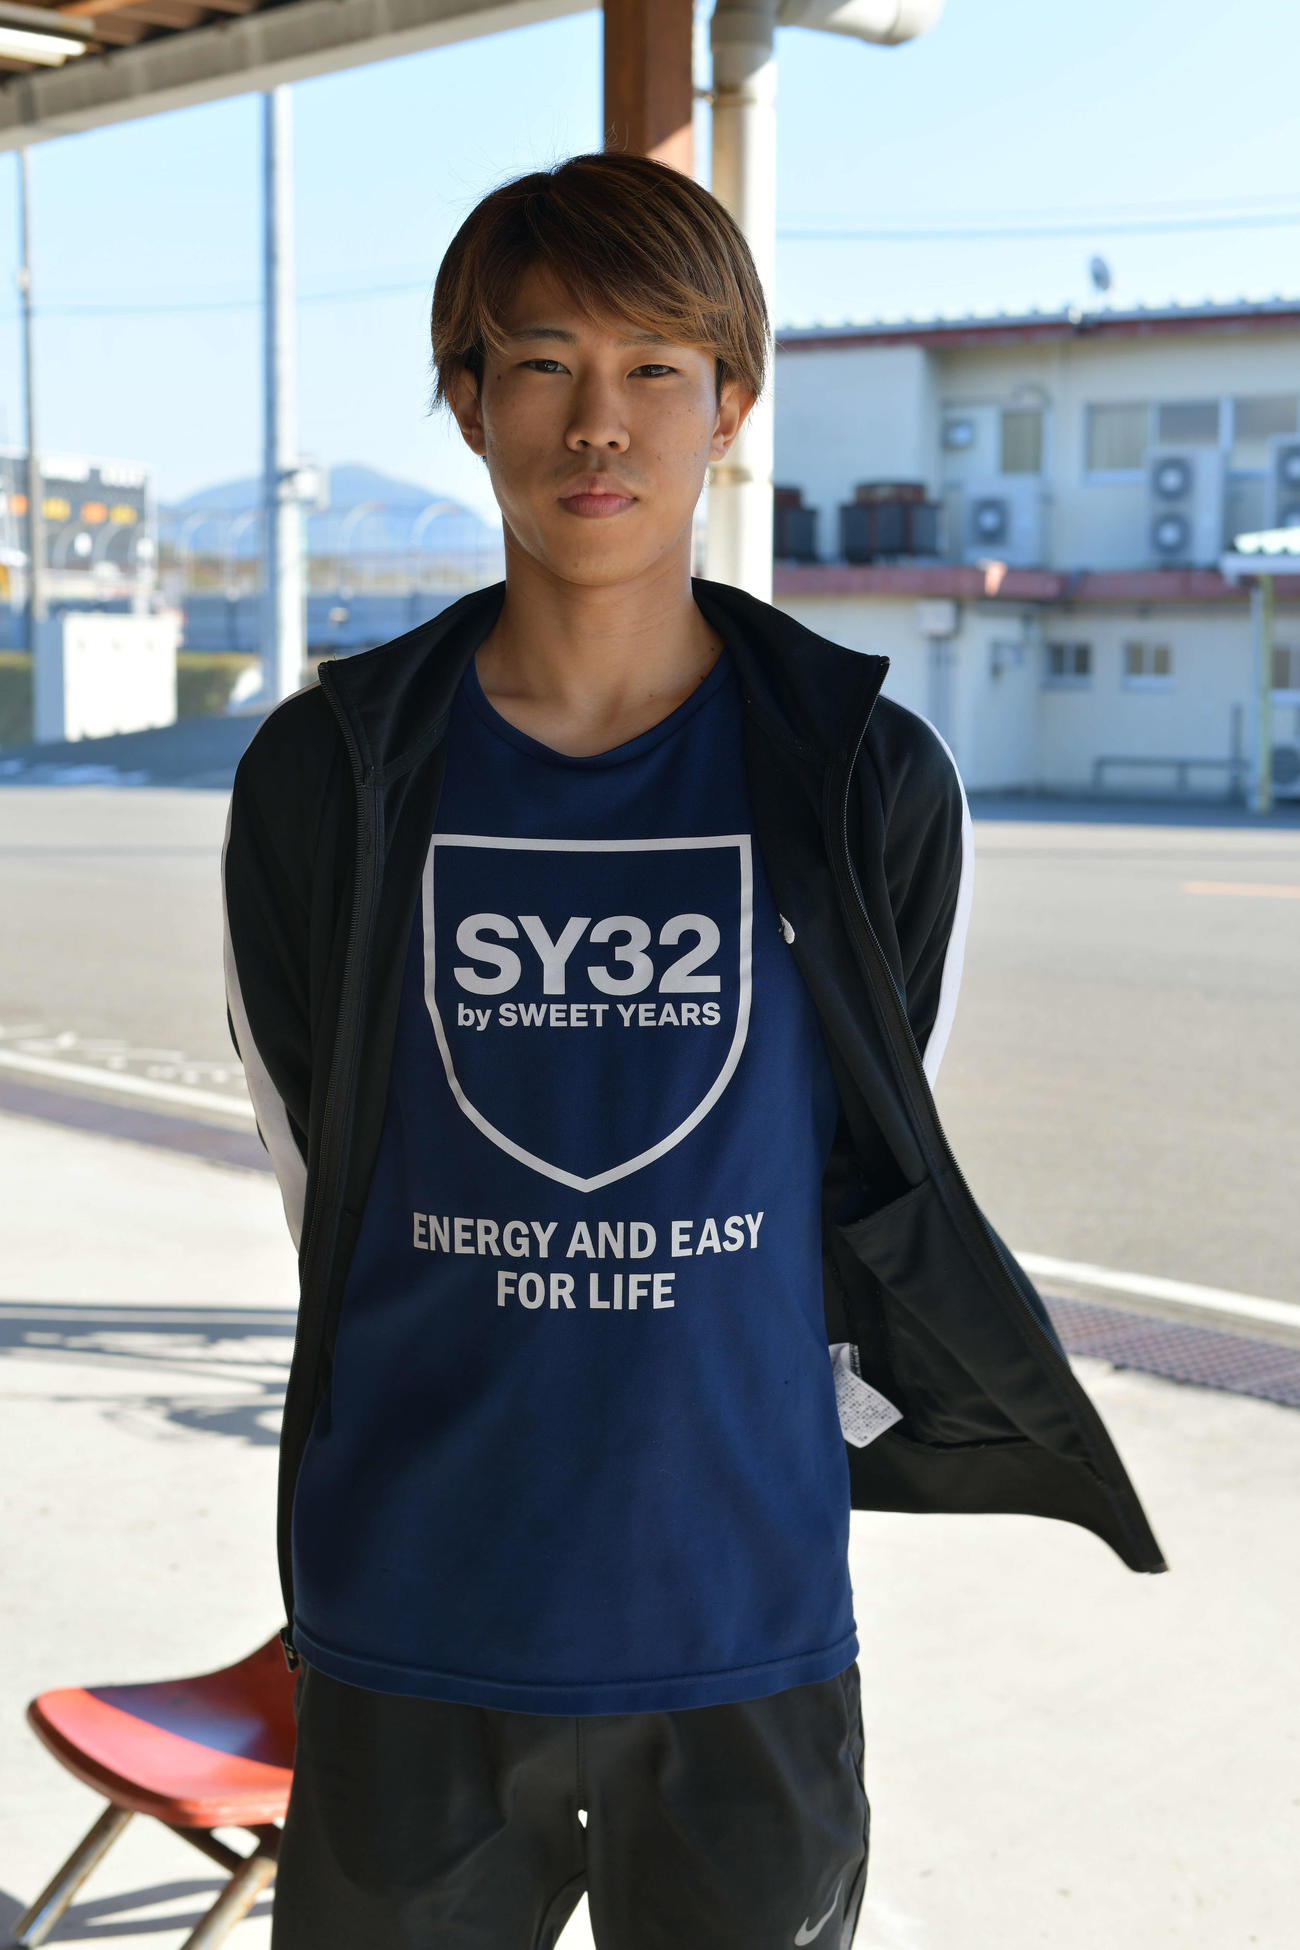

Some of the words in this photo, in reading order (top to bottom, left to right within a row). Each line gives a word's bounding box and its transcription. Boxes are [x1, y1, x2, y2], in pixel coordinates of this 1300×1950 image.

[453, 913, 721, 996] SY32
[457, 1003, 492, 1031] by
[498, 1002, 609, 1027] SWEET
[616, 1002, 721, 1027] YEARS
[413, 1211, 559, 1259] ENERGY
[565, 1221, 657, 1259] AND
[671, 1211, 765, 1258] EASY
[497, 1270, 577, 1310] FOR
[589, 1272, 676, 1310] LIFE
